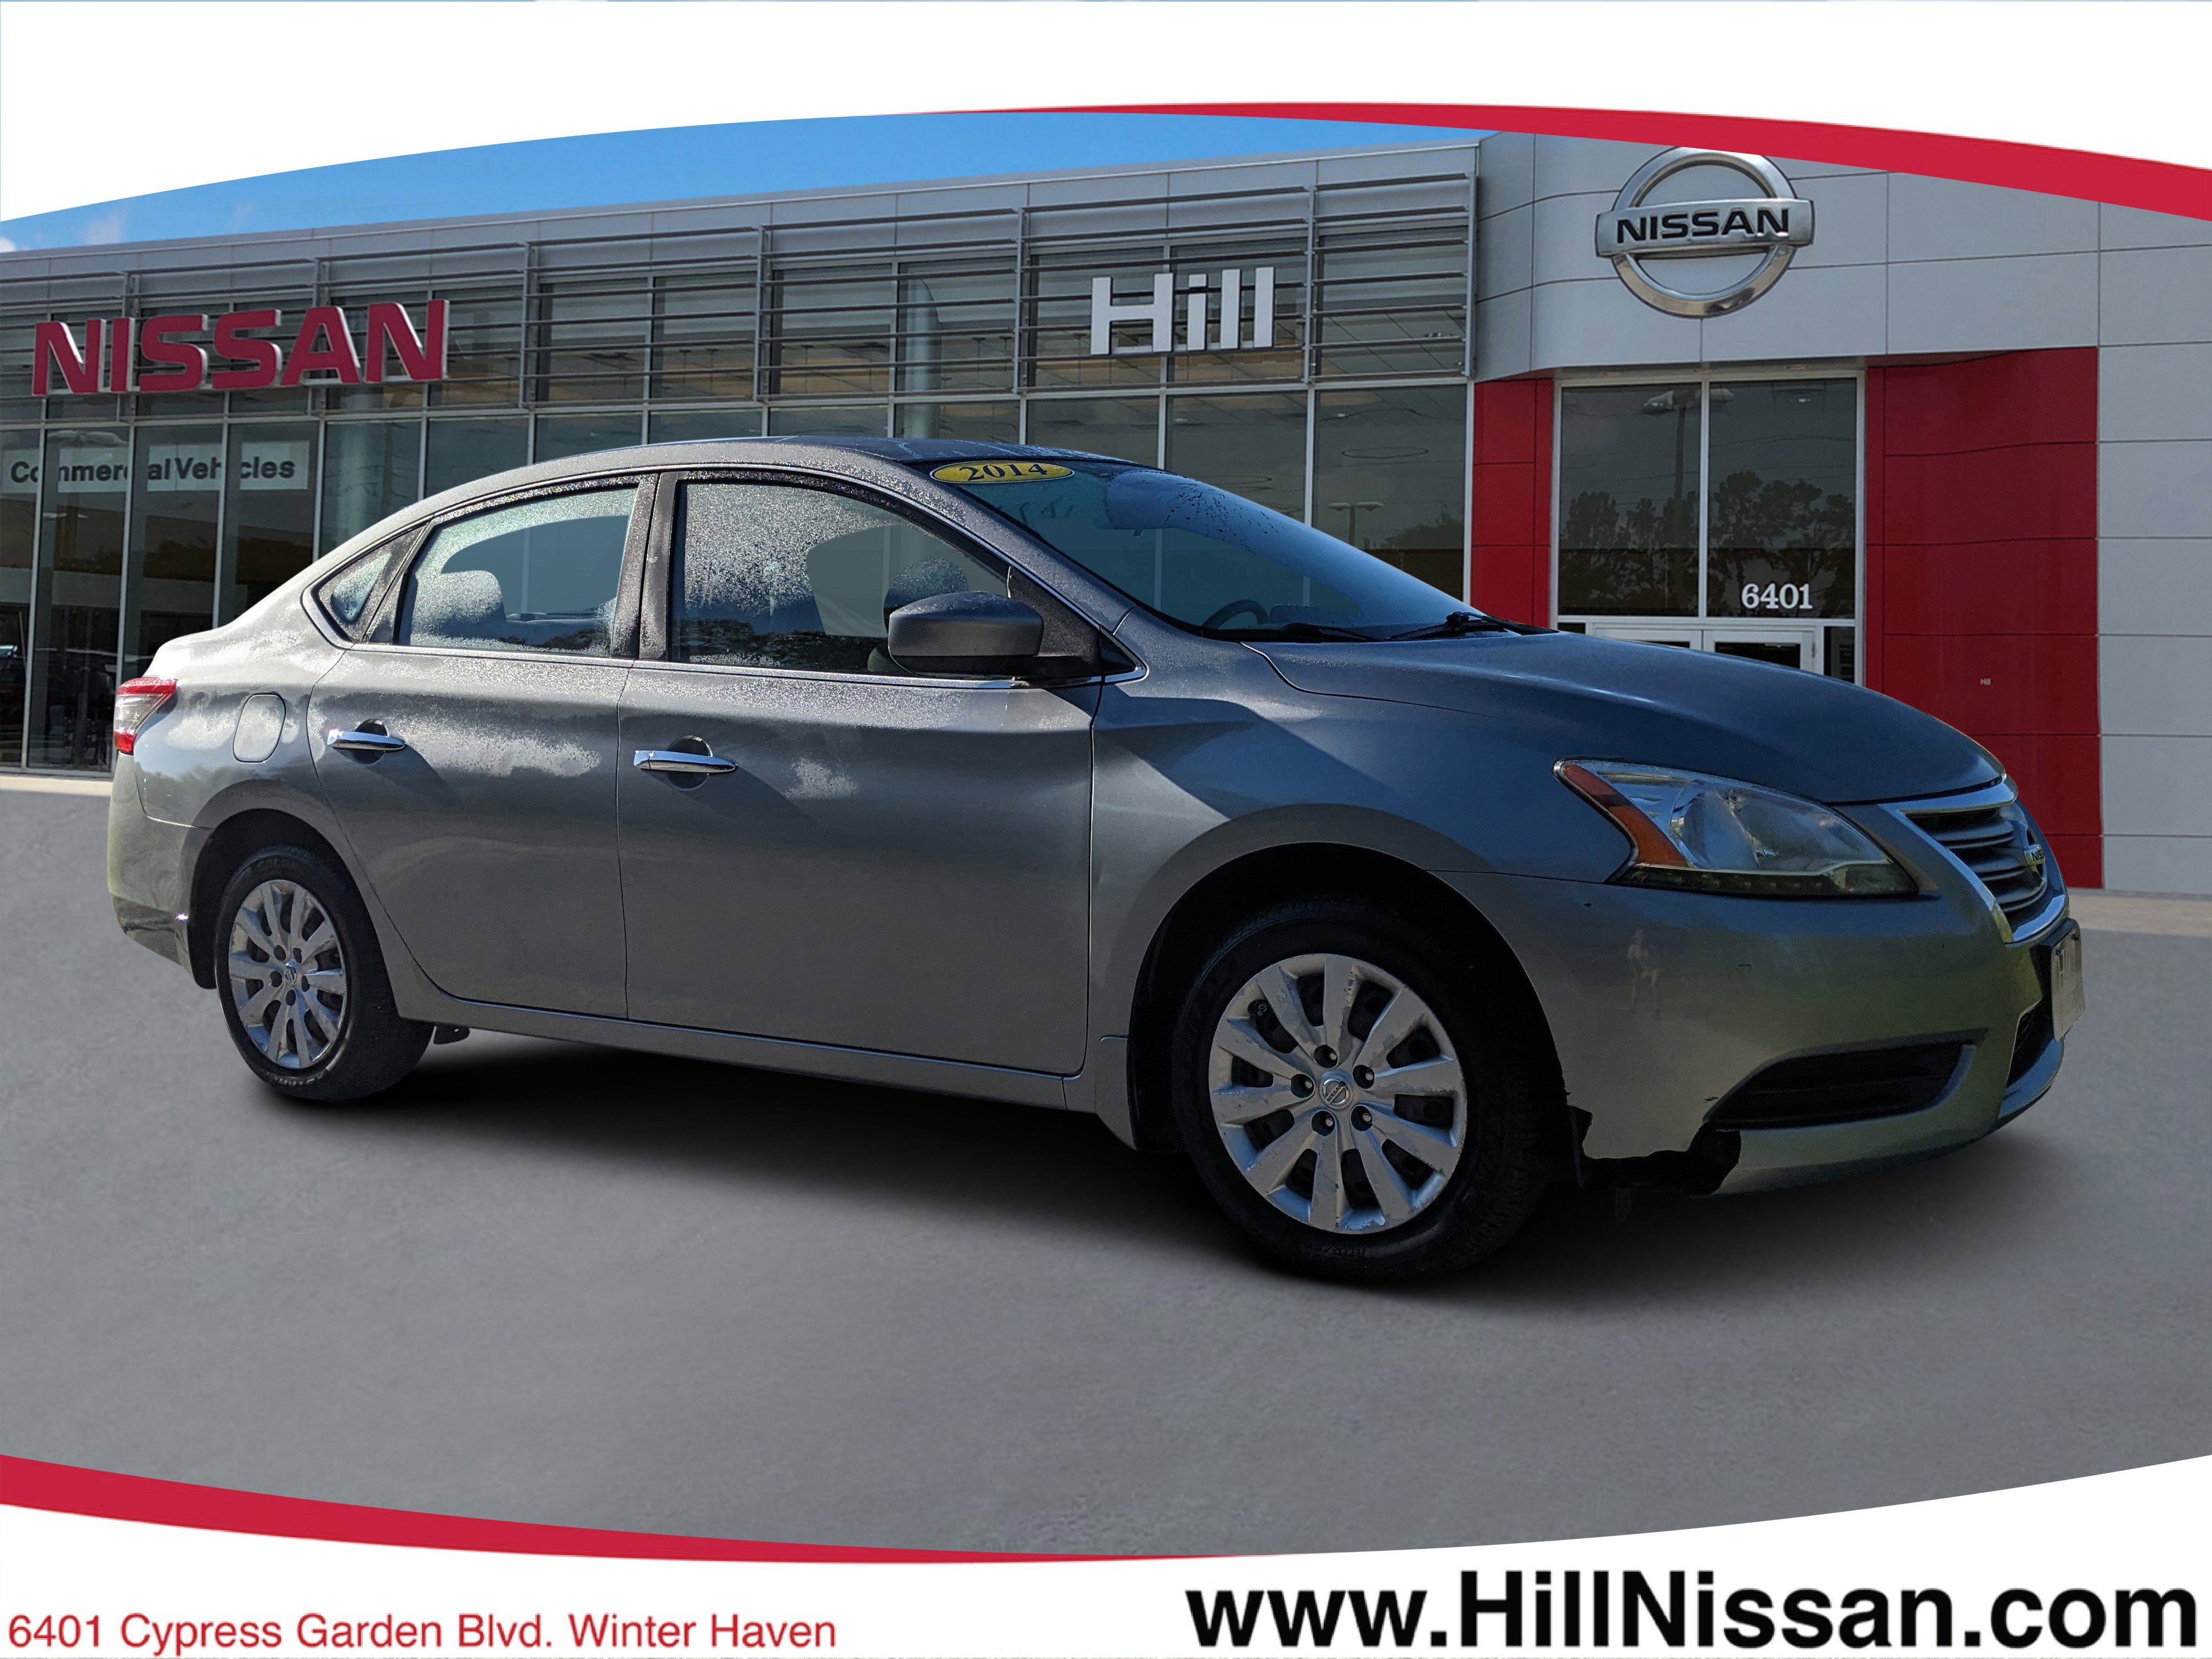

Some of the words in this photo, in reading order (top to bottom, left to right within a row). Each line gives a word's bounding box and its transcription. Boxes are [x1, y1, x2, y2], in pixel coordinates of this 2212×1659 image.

[1617, 207, 1790, 244] NISSAN
[1091, 266, 1275, 355] Hill
[31, 300, 449, 396] NISSAN
[10, 458, 171, 483] Comeral
[174, 456, 295, 479] Vehcles
[959, 463, 1048, 481] 2014
[1741, 583, 1813, 610] 6401
